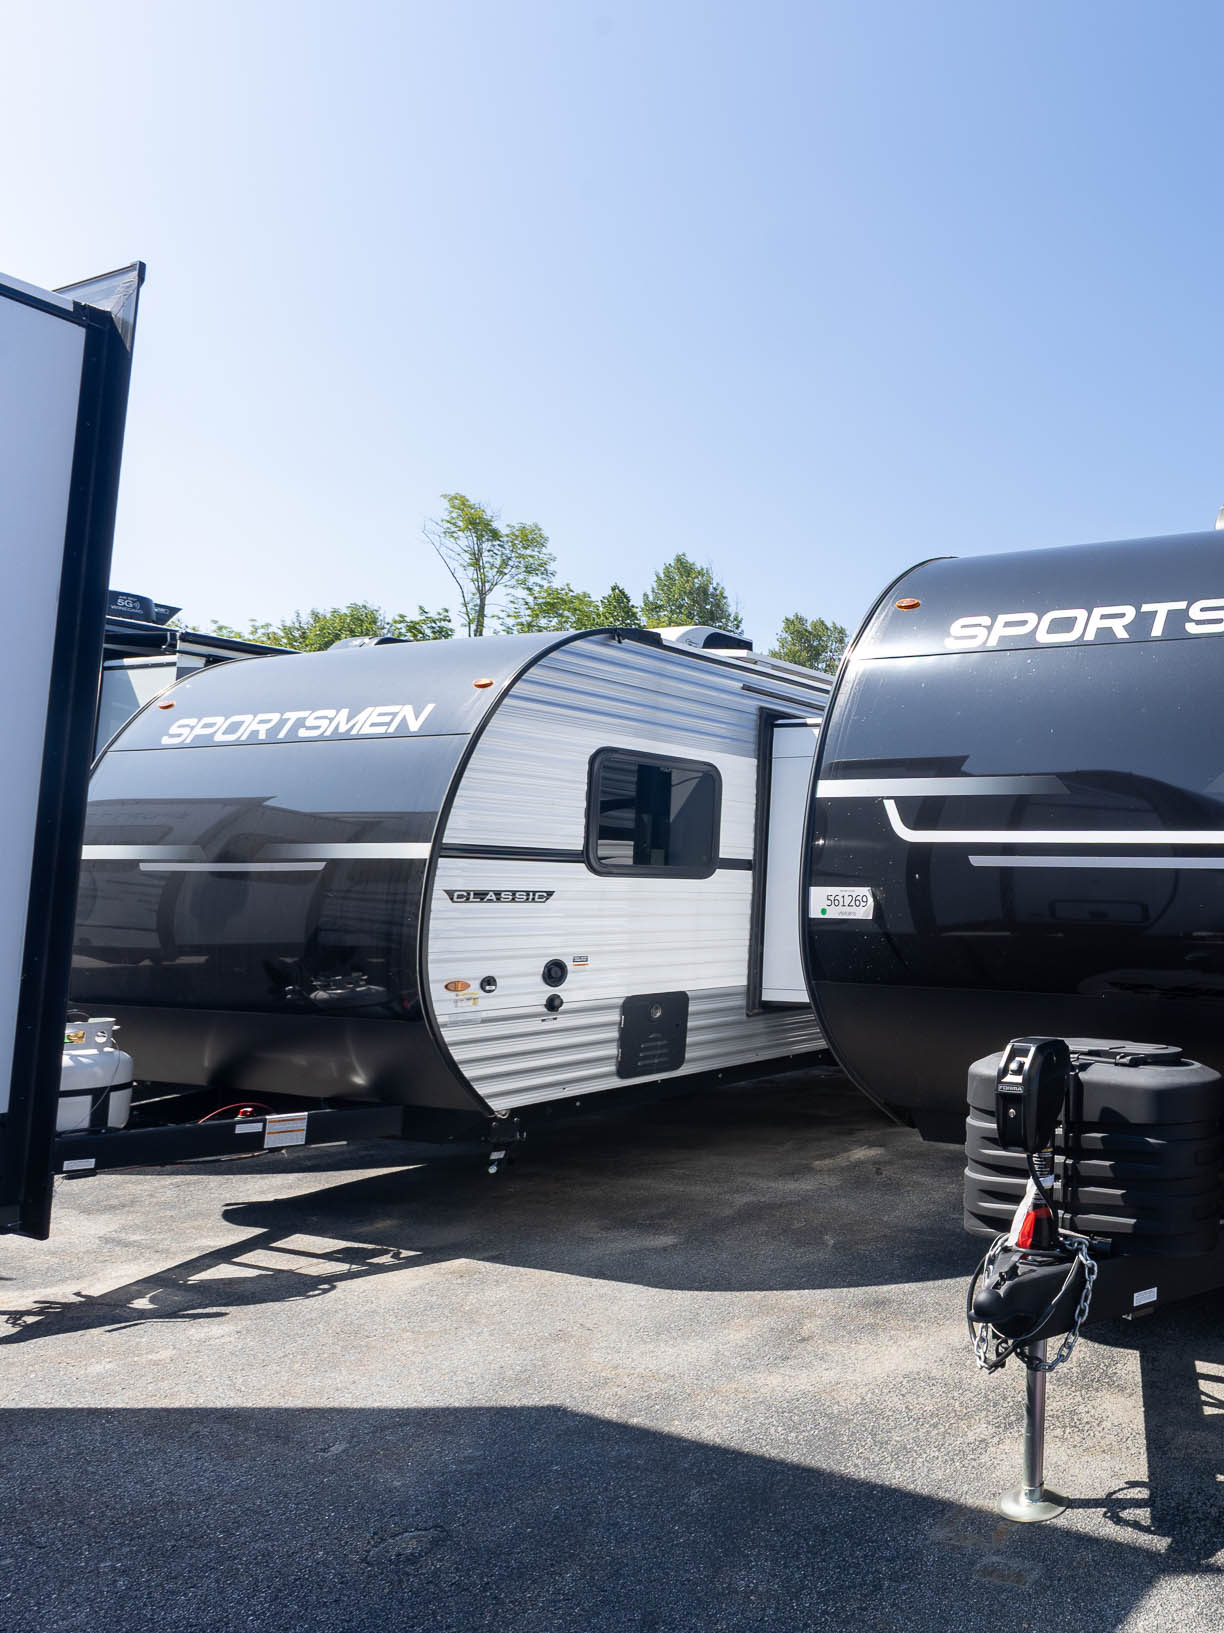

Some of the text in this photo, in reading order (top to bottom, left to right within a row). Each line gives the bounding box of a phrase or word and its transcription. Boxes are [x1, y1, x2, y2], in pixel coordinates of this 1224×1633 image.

[161, 703, 436, 745] SPORTSMEN
[453, 891, 547, 902] CLASSIC
[826, 894, 869, 907] 561269
